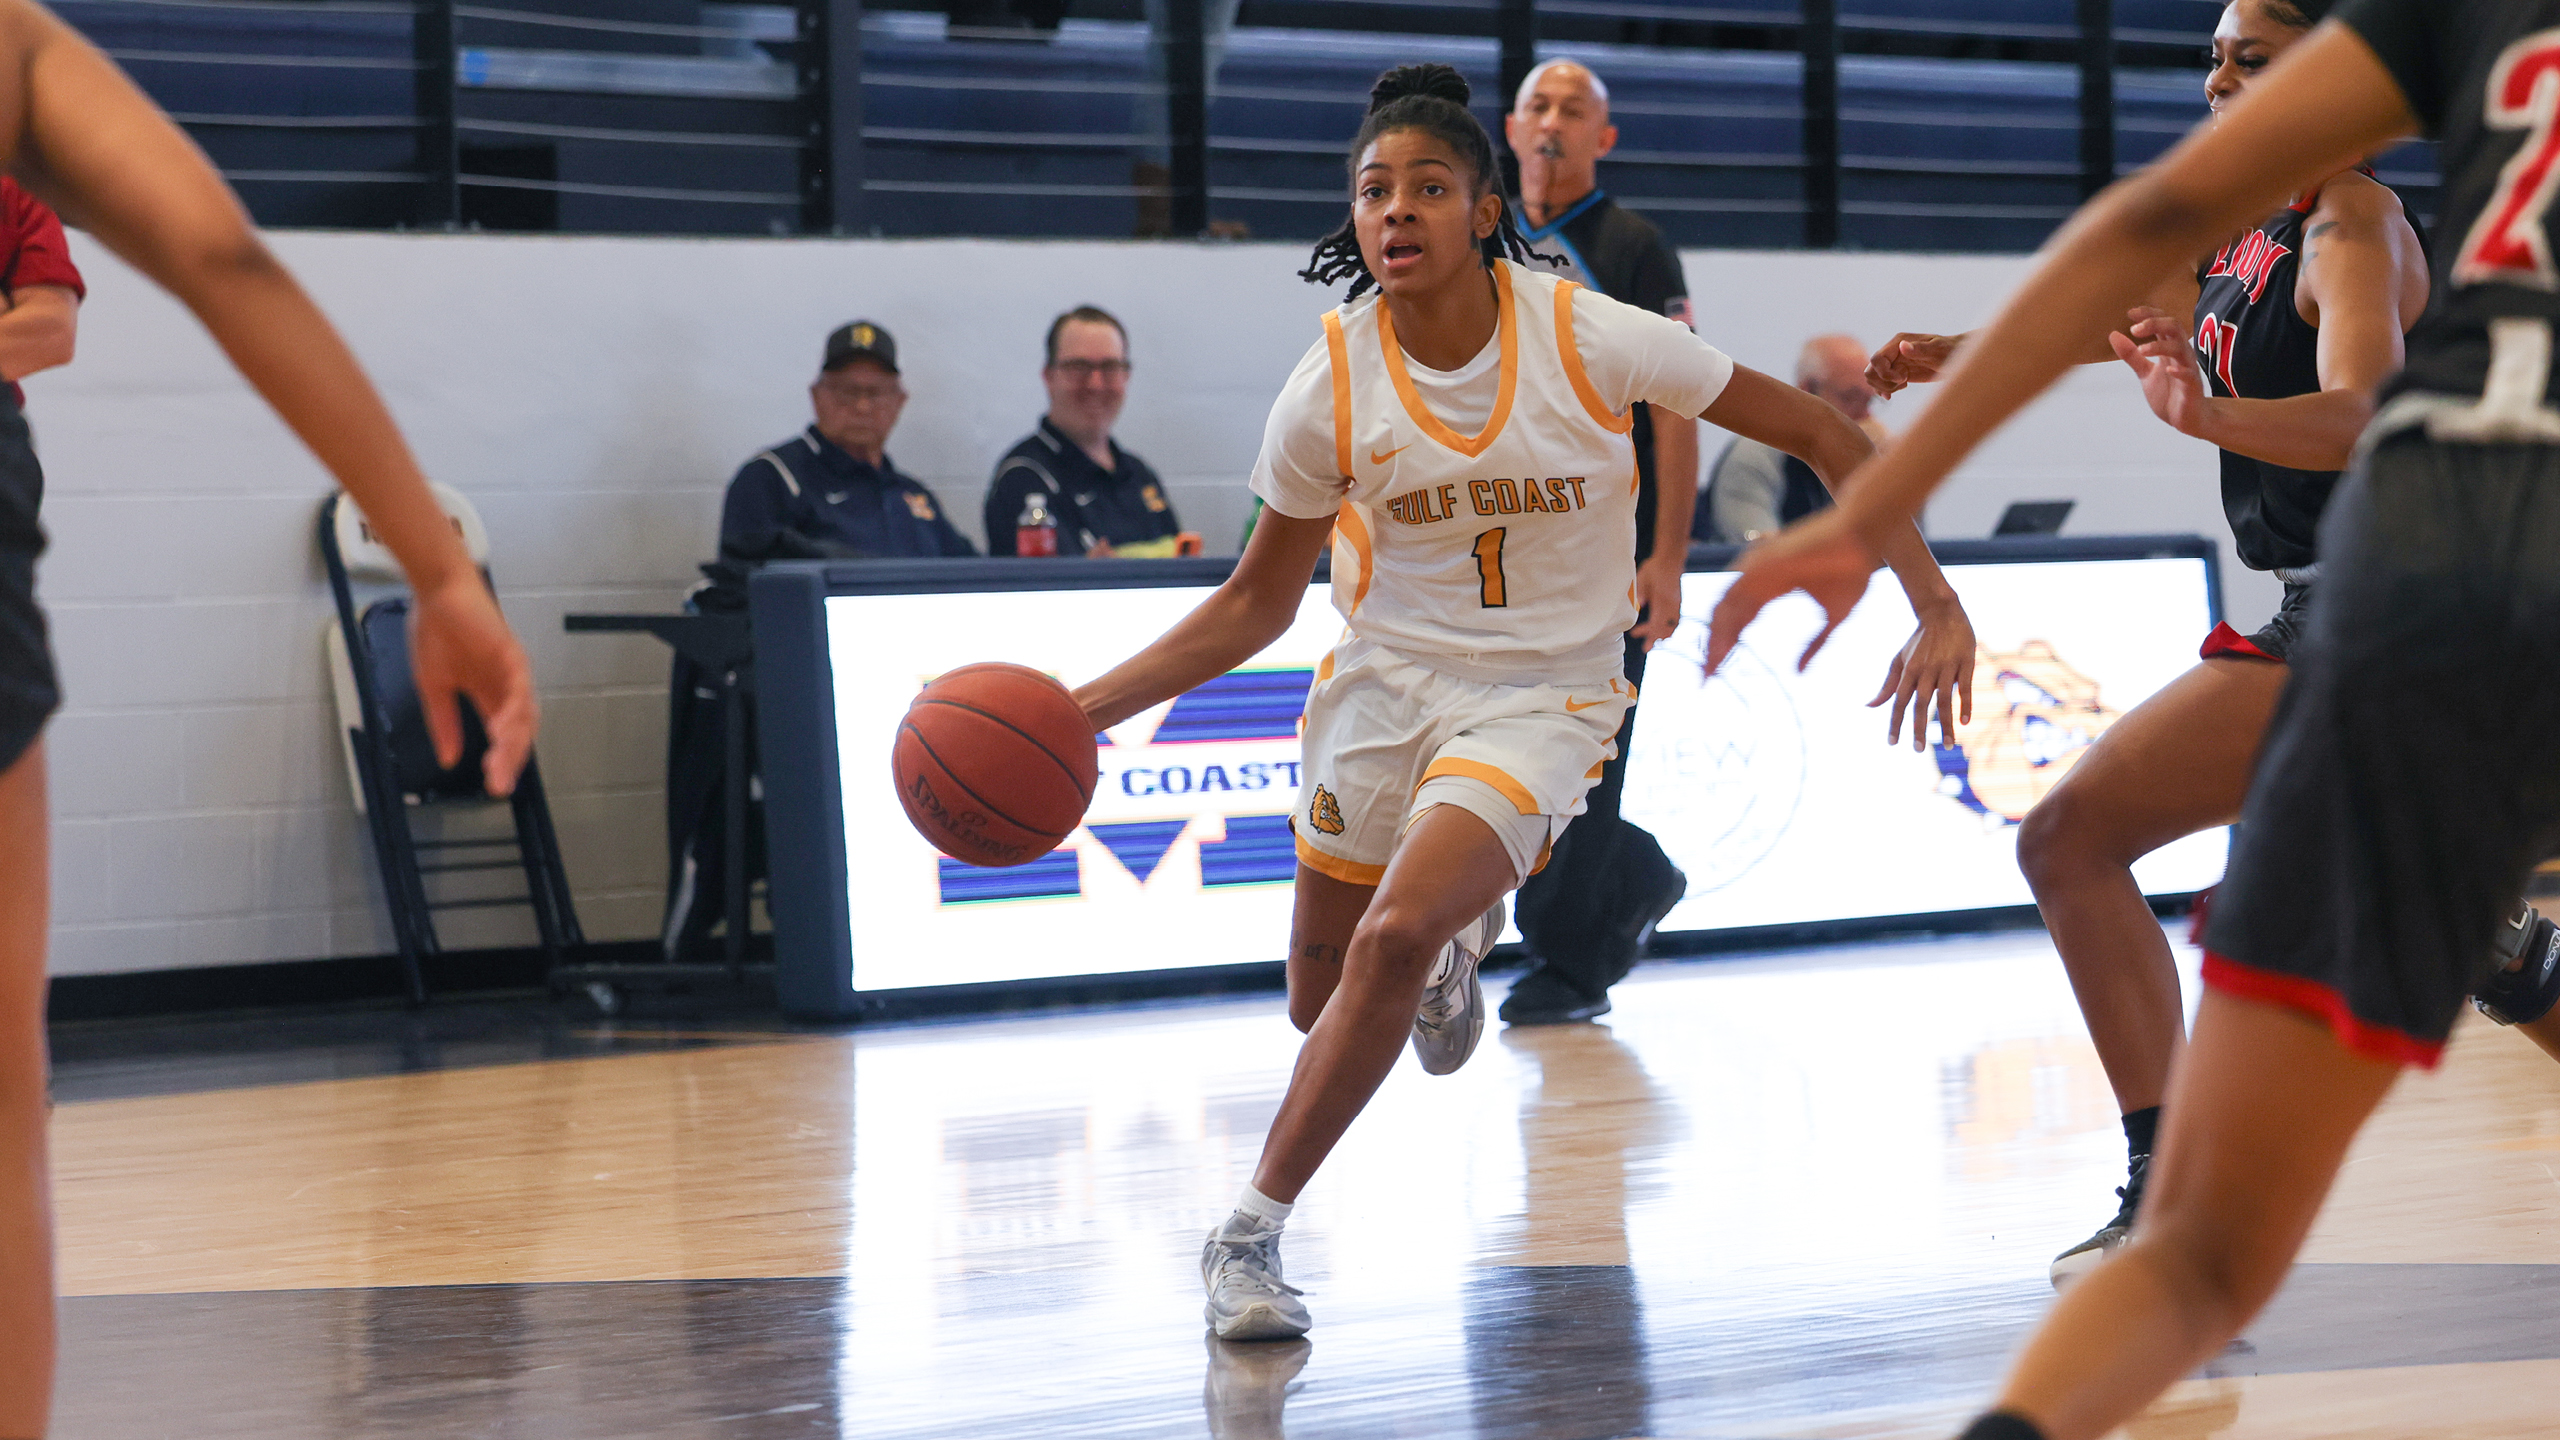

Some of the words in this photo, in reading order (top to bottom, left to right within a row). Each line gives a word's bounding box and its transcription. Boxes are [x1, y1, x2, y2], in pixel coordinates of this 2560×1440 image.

[1387, 484, 1458, 525] GULF
[1468, 477, 1586, 516] COAST
[1471, 526, 1507, 609] 1
[1120, 761, 1301, 797] COAST
